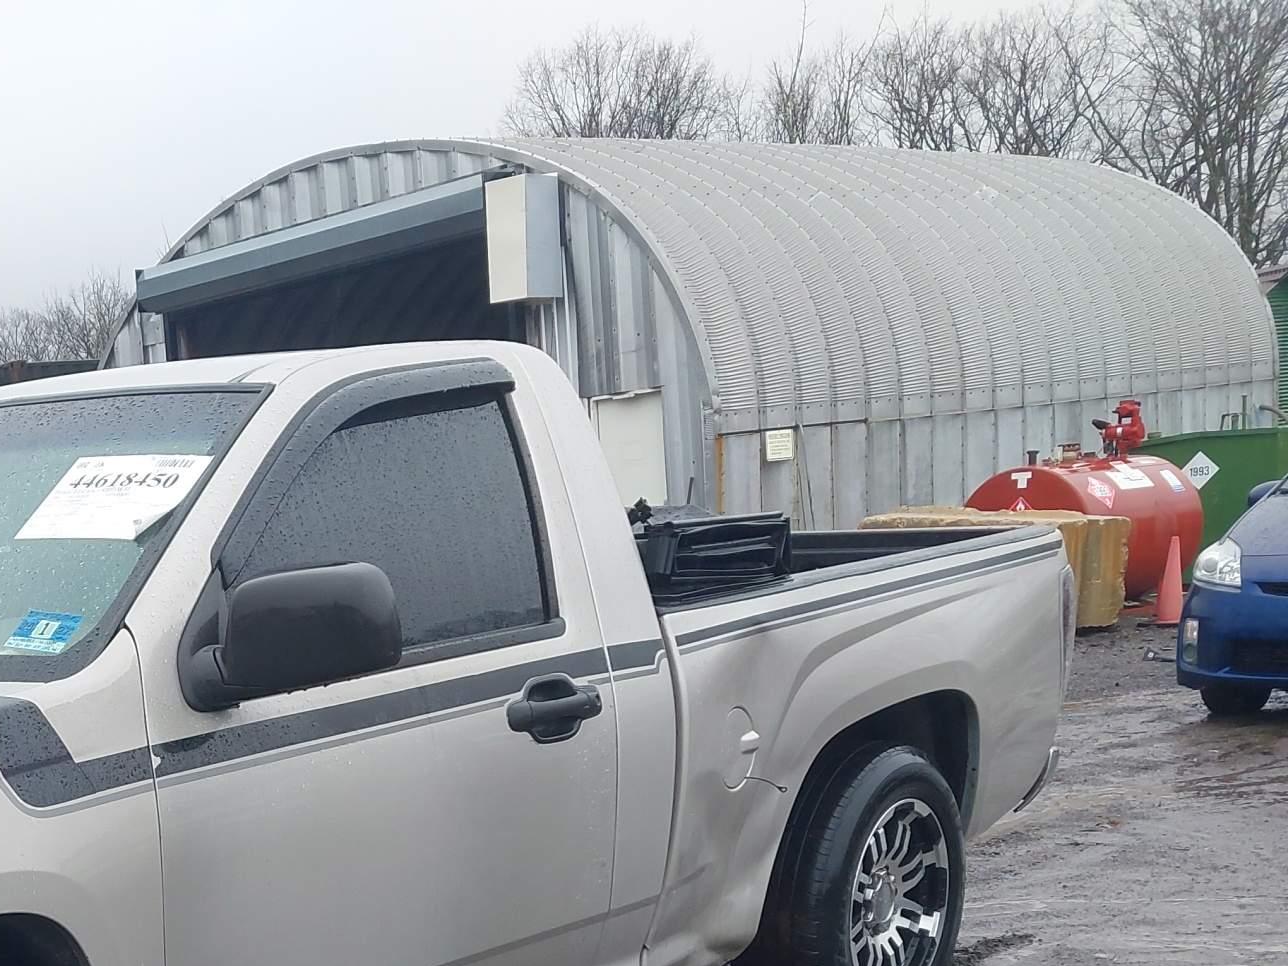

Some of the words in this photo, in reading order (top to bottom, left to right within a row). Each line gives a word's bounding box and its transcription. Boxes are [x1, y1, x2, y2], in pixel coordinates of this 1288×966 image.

[1189, 465, 1210, 477] 1993
[69, 472, 180, 489] 44618450
[38, 622, 50, 637] 1
